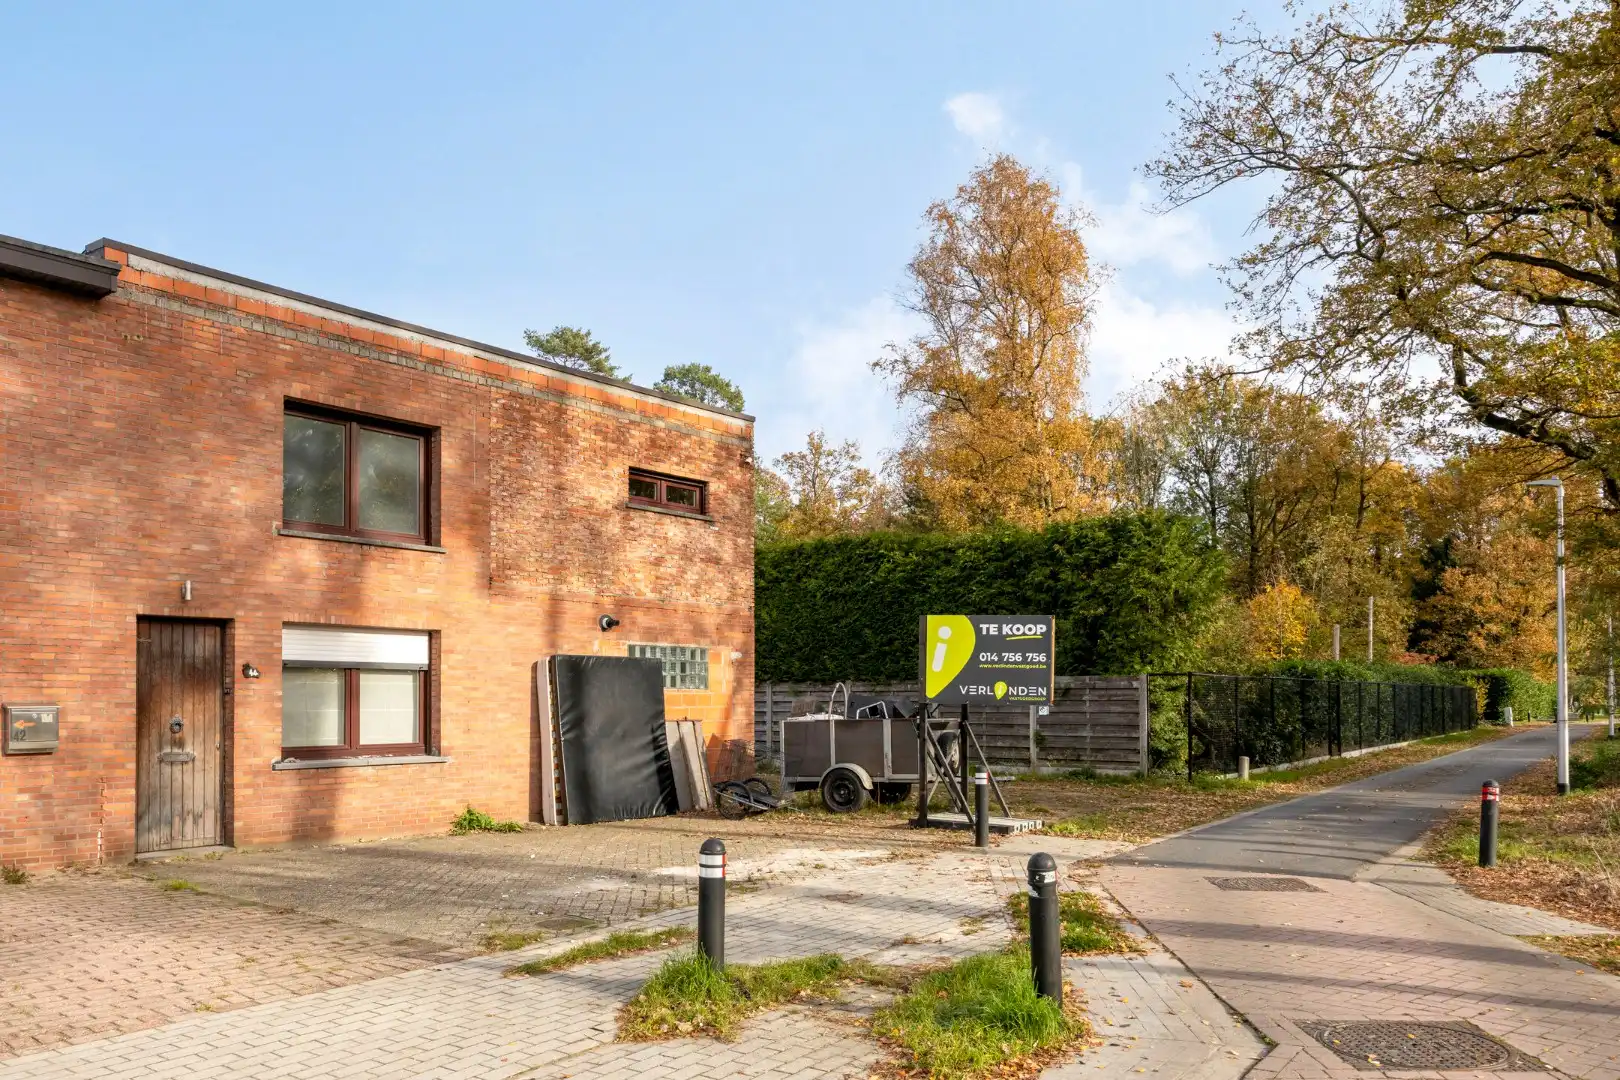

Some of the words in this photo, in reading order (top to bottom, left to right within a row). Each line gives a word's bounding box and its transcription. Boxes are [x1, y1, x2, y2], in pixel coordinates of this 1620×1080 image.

[980, 624, 998, 635] TE
[1002, 624, 1047, 635] KOOP
[979, 652, 998, 662] 014
[1002, 653, 1022, 662] 756
[1026, 653, 1047, 662] 756
[248, 668, 258, 676] 44
[13, 730, 26, 741] 42
